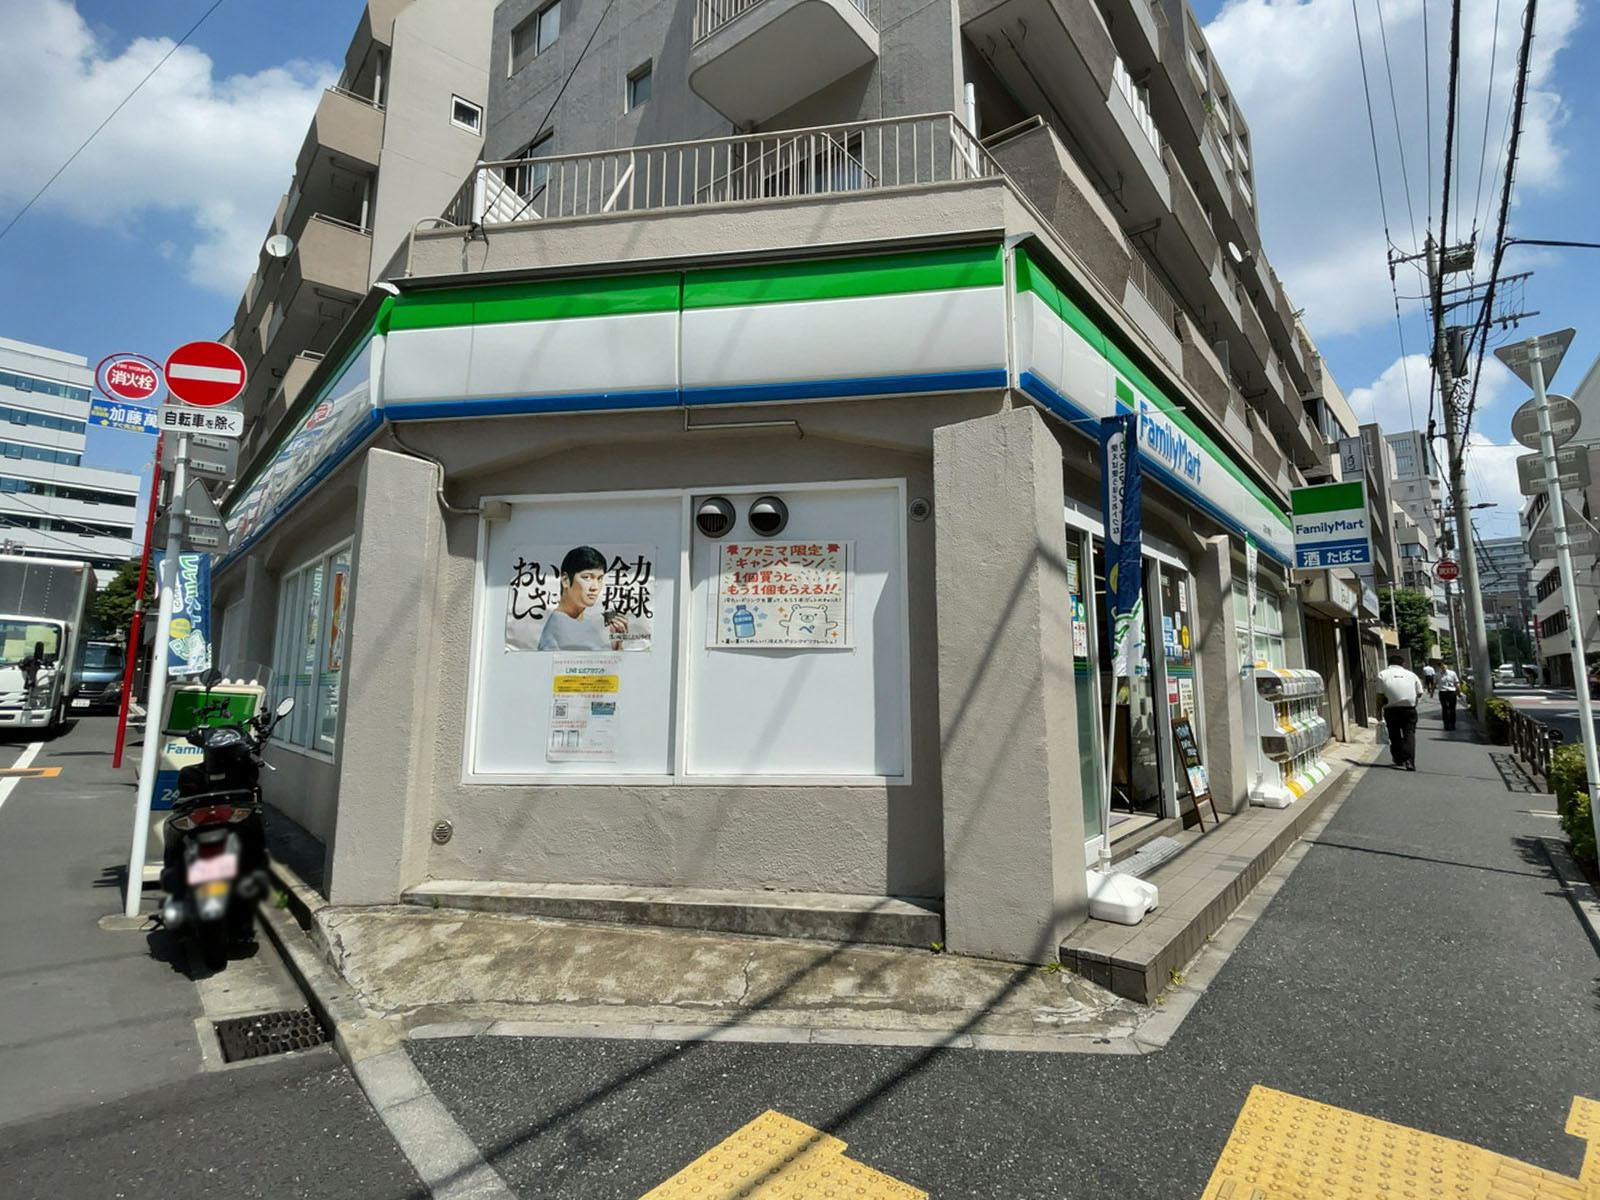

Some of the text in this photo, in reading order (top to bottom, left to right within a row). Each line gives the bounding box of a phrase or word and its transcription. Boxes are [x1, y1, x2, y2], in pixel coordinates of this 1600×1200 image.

[111, 369, 154, 390] 消火栓
[164, 411, 236, 431] 自転車を除く
[1139, 399, 1201, 485] FamilyMart
[1295, 519, 1364, 535] FamilyMart
[741, 544, 823, 557] ファミマ限定
[1303, 549, 1364, 567] 酒 たばこ
[605, 555, 652, 586] 全力
